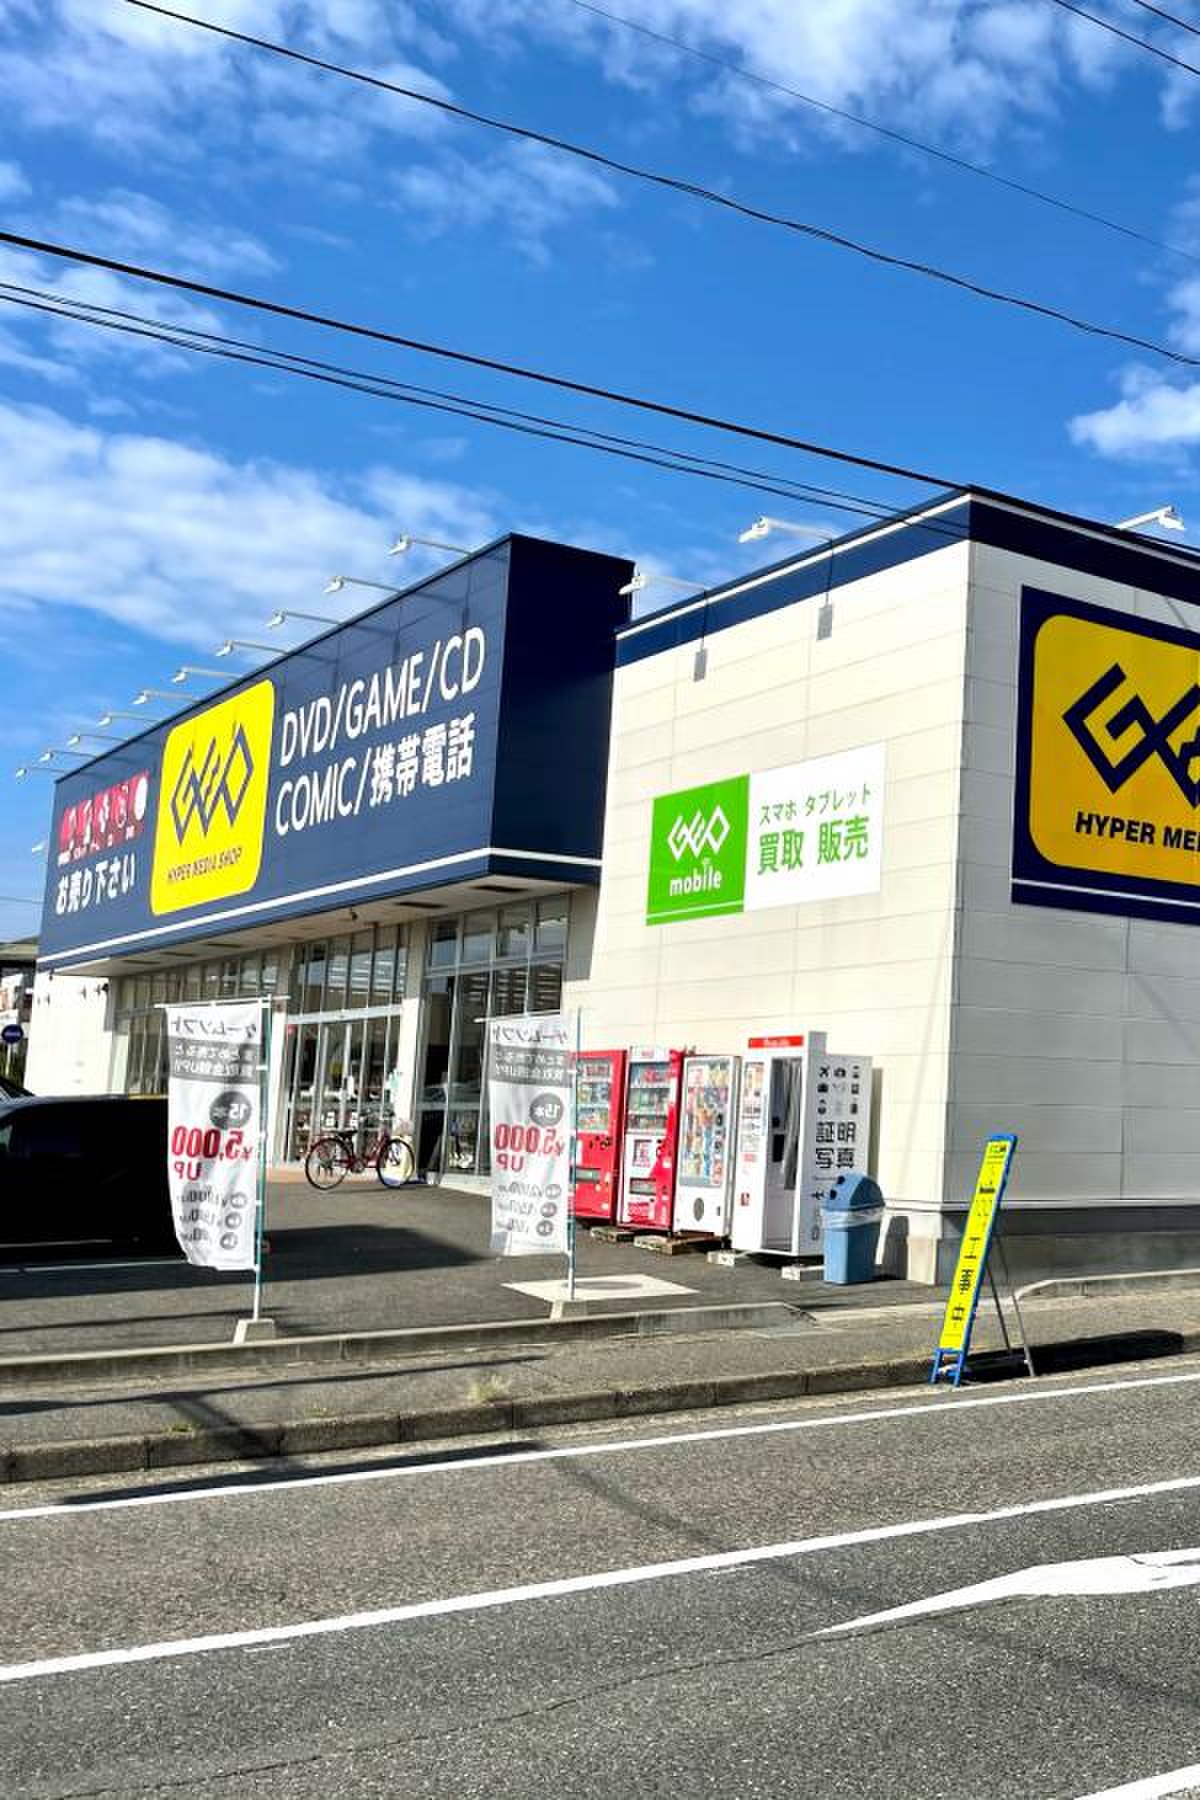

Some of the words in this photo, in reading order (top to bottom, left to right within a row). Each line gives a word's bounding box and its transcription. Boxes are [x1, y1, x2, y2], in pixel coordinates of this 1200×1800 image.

[280, 627, 485, 767] DVD/GAME/CD
[275, 712, 475, 836] COMIC/携帯電話
[759, 799, 798, 826] スマホ
[805, 783, 871, 817] タブレット
[757, 829, 805, 876] 買取
[817, 814, 870, 865] 販売
[1075, 811, 1155, 845] HYPER
[56, 853, 136, 915] お売り下さい
[669, 858, 722, 896] mobile
[816, 1121, 856, 1144] 証明
[816, 1147, 856, 1169] 写真
